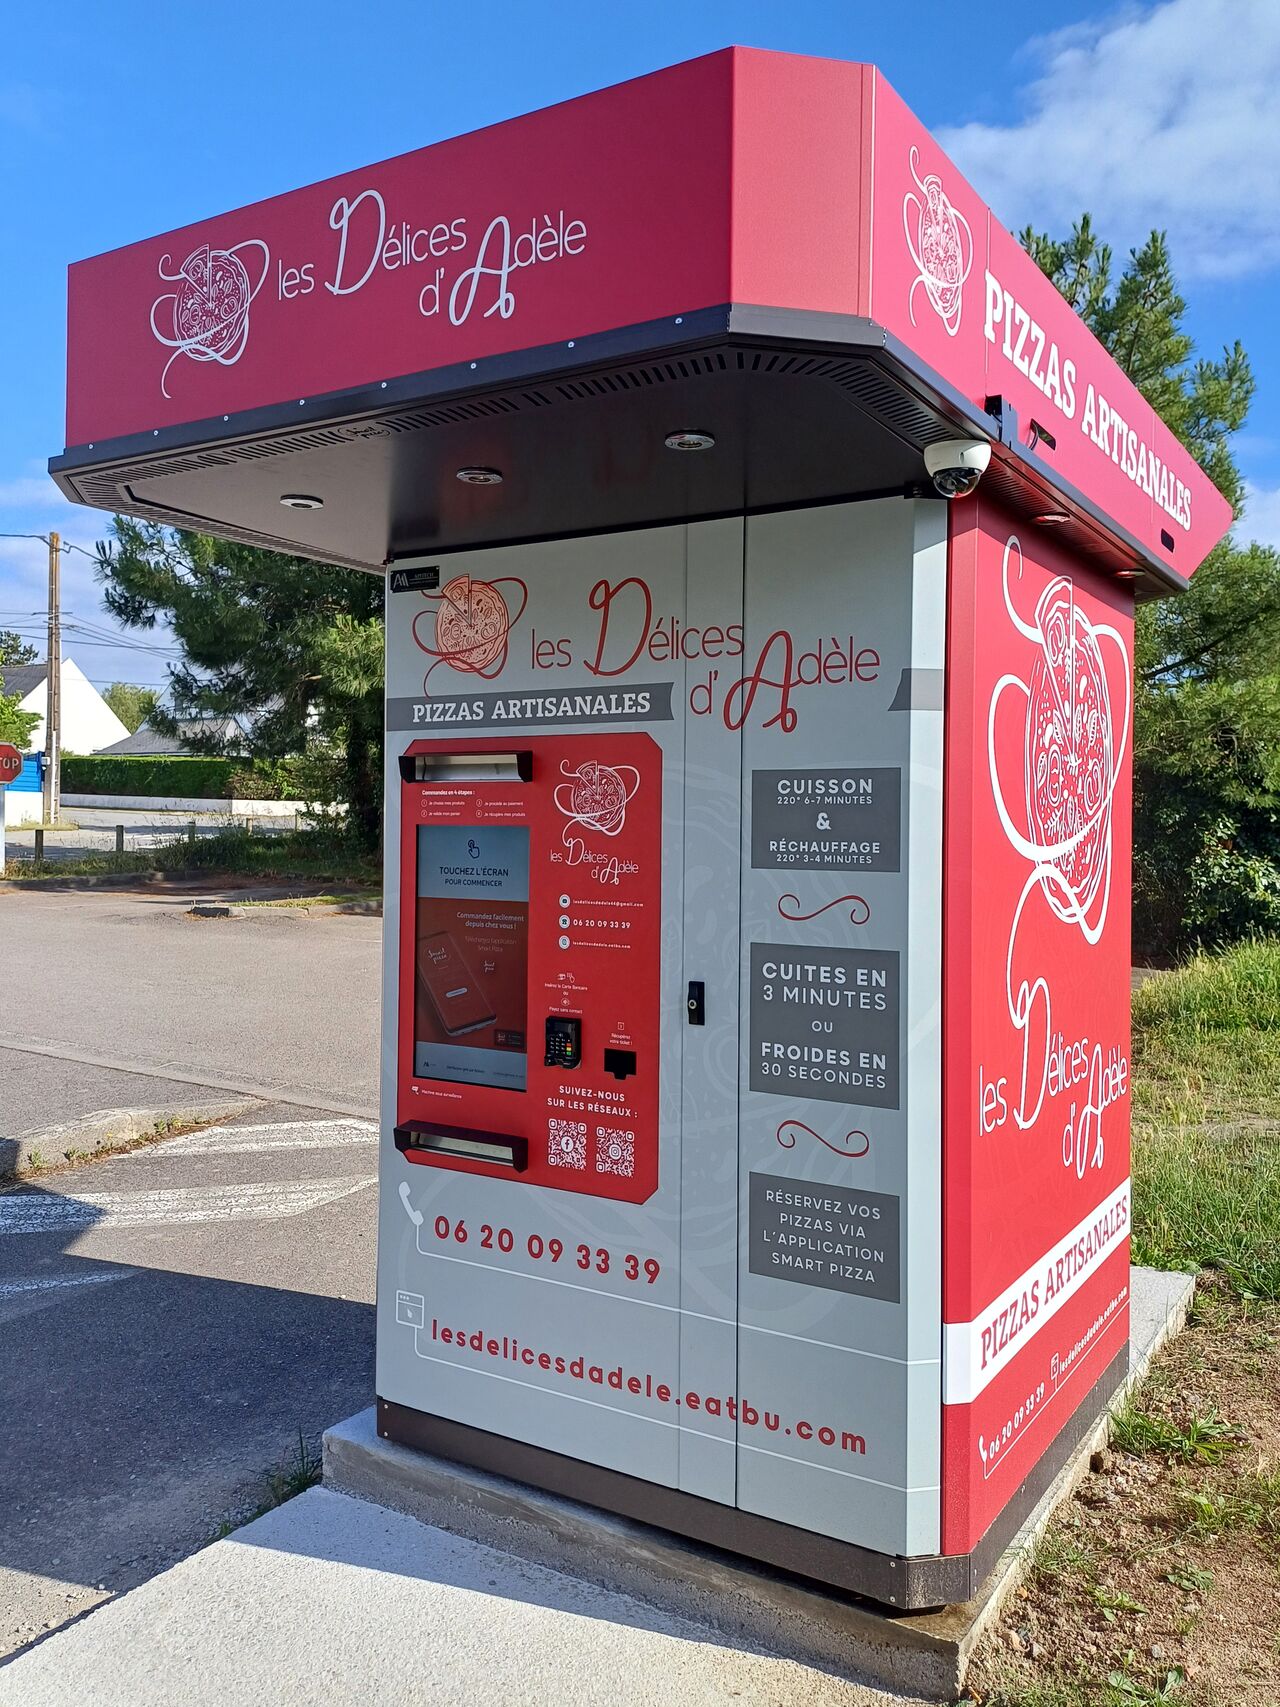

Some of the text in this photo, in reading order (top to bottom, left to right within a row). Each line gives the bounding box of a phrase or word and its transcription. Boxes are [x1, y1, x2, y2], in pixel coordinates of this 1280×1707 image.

[278, 189, 588, 326] les Délices d'Adèle
[983, 268, 1192, 532] PIZZAS ARTISANALES
[531, 577, 881, 733] les Délices d'Adèle
[412, 691, 651, 724] PIZZAS ARTISANALES
[777, 778, 873, 795] CUISSON
[777, 795, 873, 805] 220° 6-7 MINUTES
[816, 812, 832, 830] &
[550, 849, 563, 862] les
[565, 838, 609, 866] Délices
[769, 838, 880, 854] RÉCHAUFFAGE
[776, 853, 873, 864] 220° 3-4 MINUTES
[440, 866, 509, 877] TOUCHEZ L'ÉCRAN
[444, 878, 503, 887] POUR COMMENCER
[456, 911, 492, 920] Commandez
[465, 920, 484, 929] depuis
[485, 921, 498, 929] chez
[585, 919, 595, 927] 20
[597, 920, 608, 928] 09
[610, 921, 619, 929] 33
[762, 962, 887, 988] CUITES EN
[763, 984, 887, 1011] 3 MINUTES
[811, 1020, 833, 1033] OU
[761, 1041, 887, 1070] FROIDES EN
[979, 1063, 1008, 1137] les
[1013, 976, 1089, 1130] Délices
[761, 1062, 887, 1089] 30 SECONDES
[547, 1097, 565, 1108] SUR
[568, 1100, 585, 1110] LES
[587, 1102, 631, 1117] RÉSEAUX
[559, 1085, 625, 1102] SUIVEZ-NOUS
[766, 1189, 881, 1220] RÉSERVEZ VOS
[780, 1212, 866, 1239] PIZZAS VIA
[434, 1215, 660, 1284] 06 20 09 33 39
[763, 1230, 884, 1263] L'APPLICATION
[772, 1252, 875, 1282] SMART PIZZA
[980, 1195, 1127, 1371] PIZZAS ARTISANALES
[432, 1319, 867, 1455] lesdelicesdadele.eatbu.com
[989, 1382, 1045, 1459] 06 20 09 33 39
